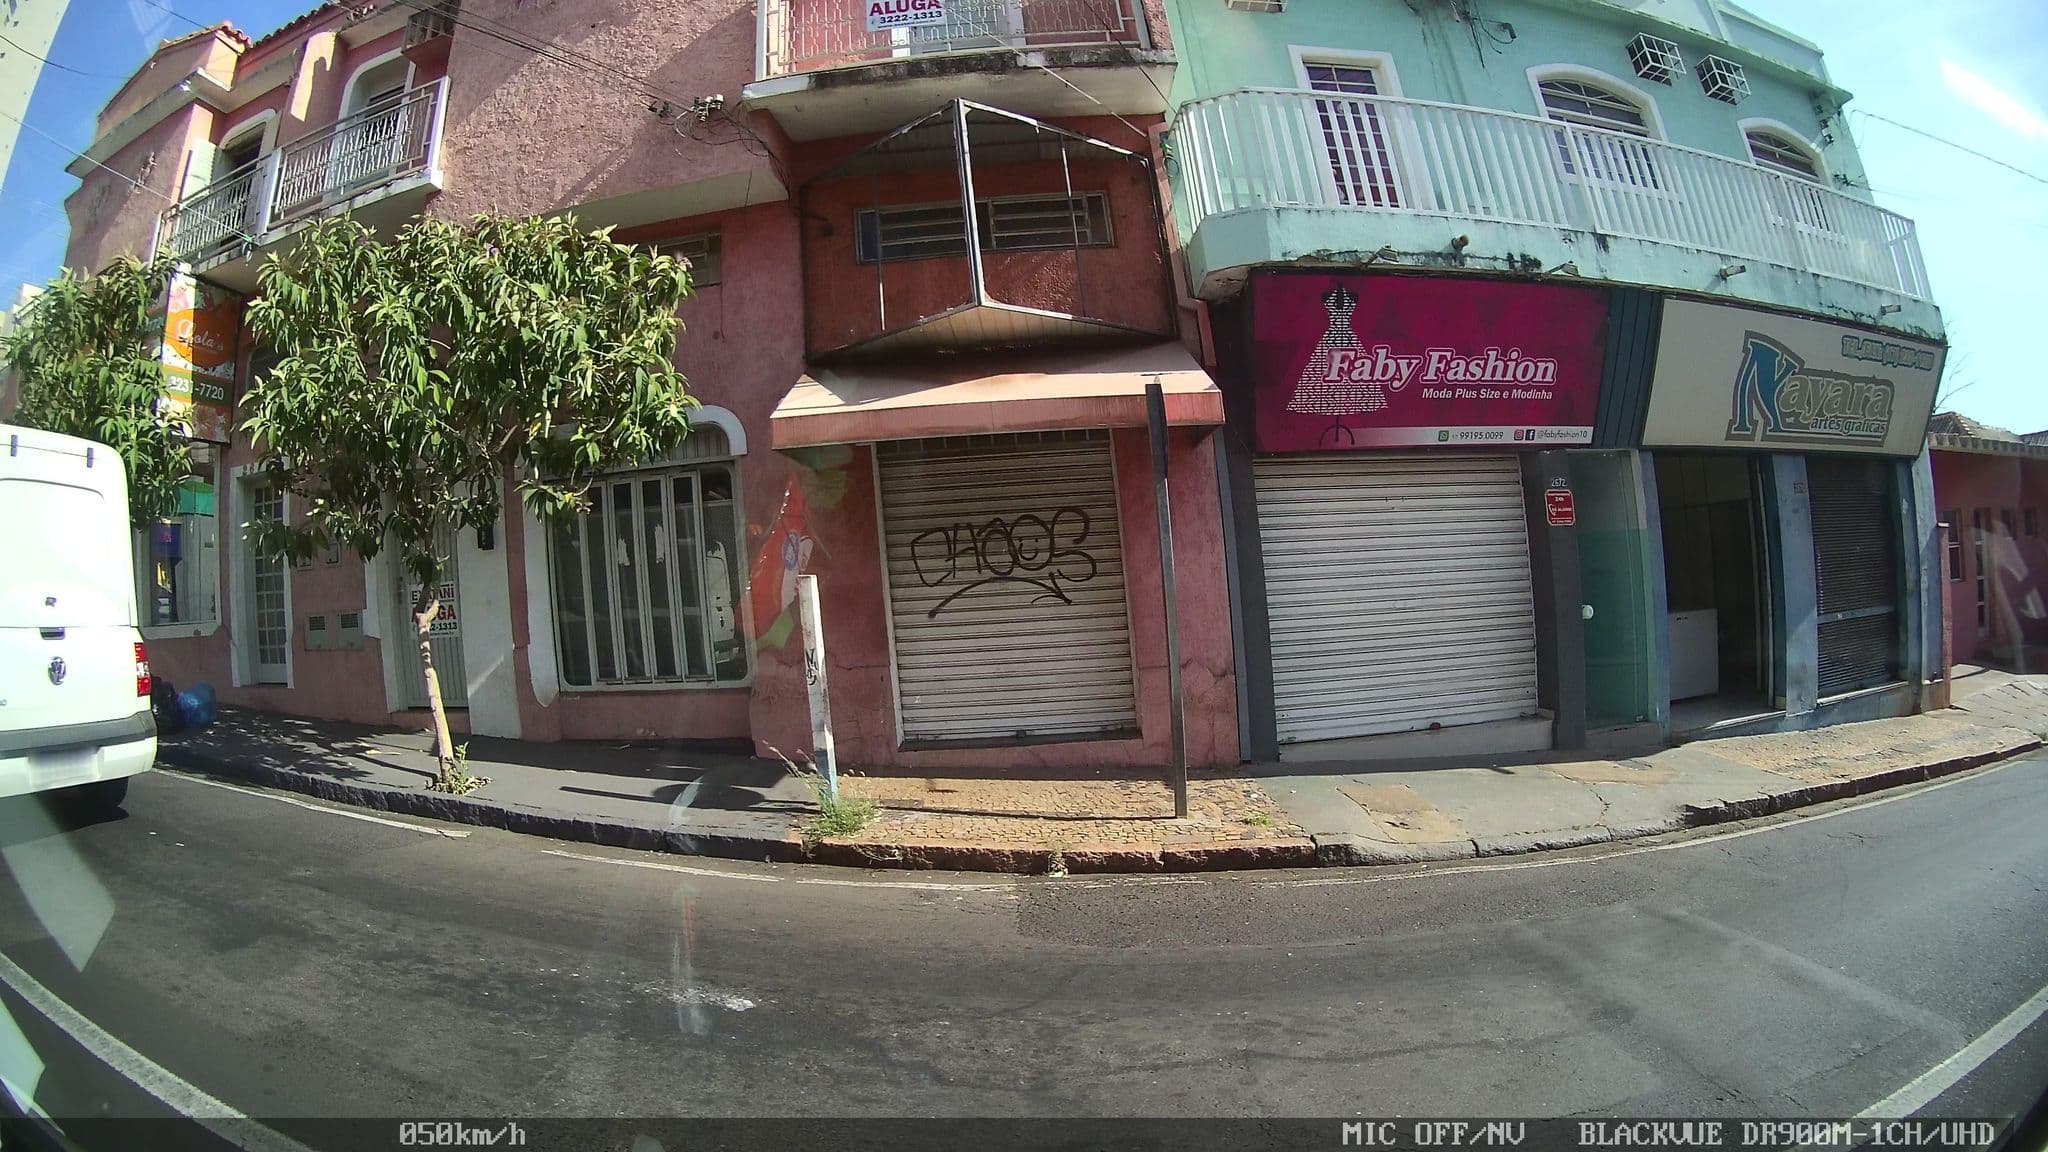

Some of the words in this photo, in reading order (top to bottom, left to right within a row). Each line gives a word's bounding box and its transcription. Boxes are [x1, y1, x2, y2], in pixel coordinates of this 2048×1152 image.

[869, 0, 943, 16] ALUGA
[880, 11, 943, 24] 3222-1313
[1322, 345, 1422, 391] Faby
[1420, 347, 1558, 385] Fashion
[1732, 338, 1891, 434] Nayara
[1422, 388, 1453, 399] Moda
[1455, 388, 1477, 399] Plus
[1479, 388, 1501, 399] Size
[1502, 390, 1510, 399] e
[1511, 389, 1553, 400] Modinha
[1810, 417, 1843, 431] artes
